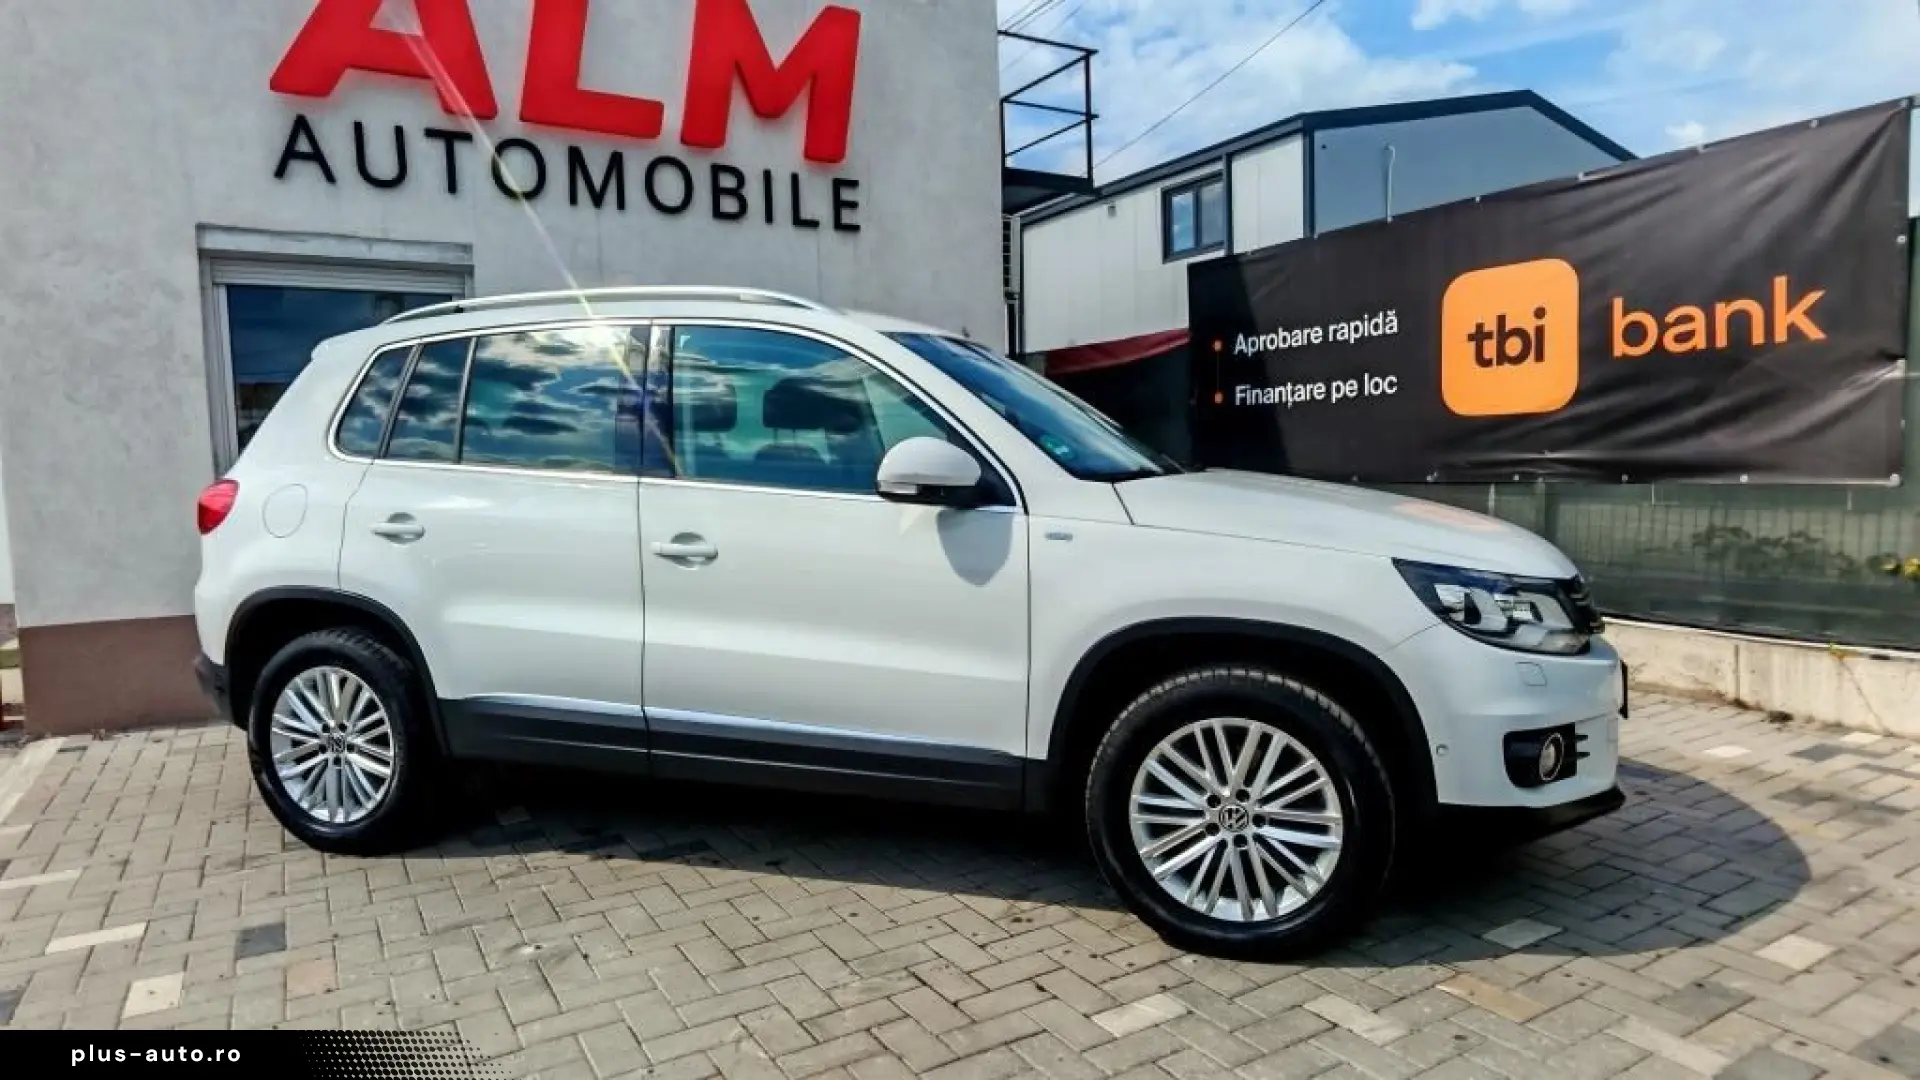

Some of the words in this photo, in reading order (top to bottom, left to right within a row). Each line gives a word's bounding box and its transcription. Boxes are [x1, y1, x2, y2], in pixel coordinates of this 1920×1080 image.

[269, 0, 862, 164] ALM
[273, 113, 862, 232] AUTOMOBILE
[1233, 326, 1324, 357] Aprobare
[1328, 308, 1399, 345] rapidă
[1466, 305, 1548, 368] tbi
[1611, 275, 1828, 359] bank
[1234, 381, 1327, 410] Finanțare
[1330, 378, 1359, 404] pe
[1363, 372, 1398, 397] loc
